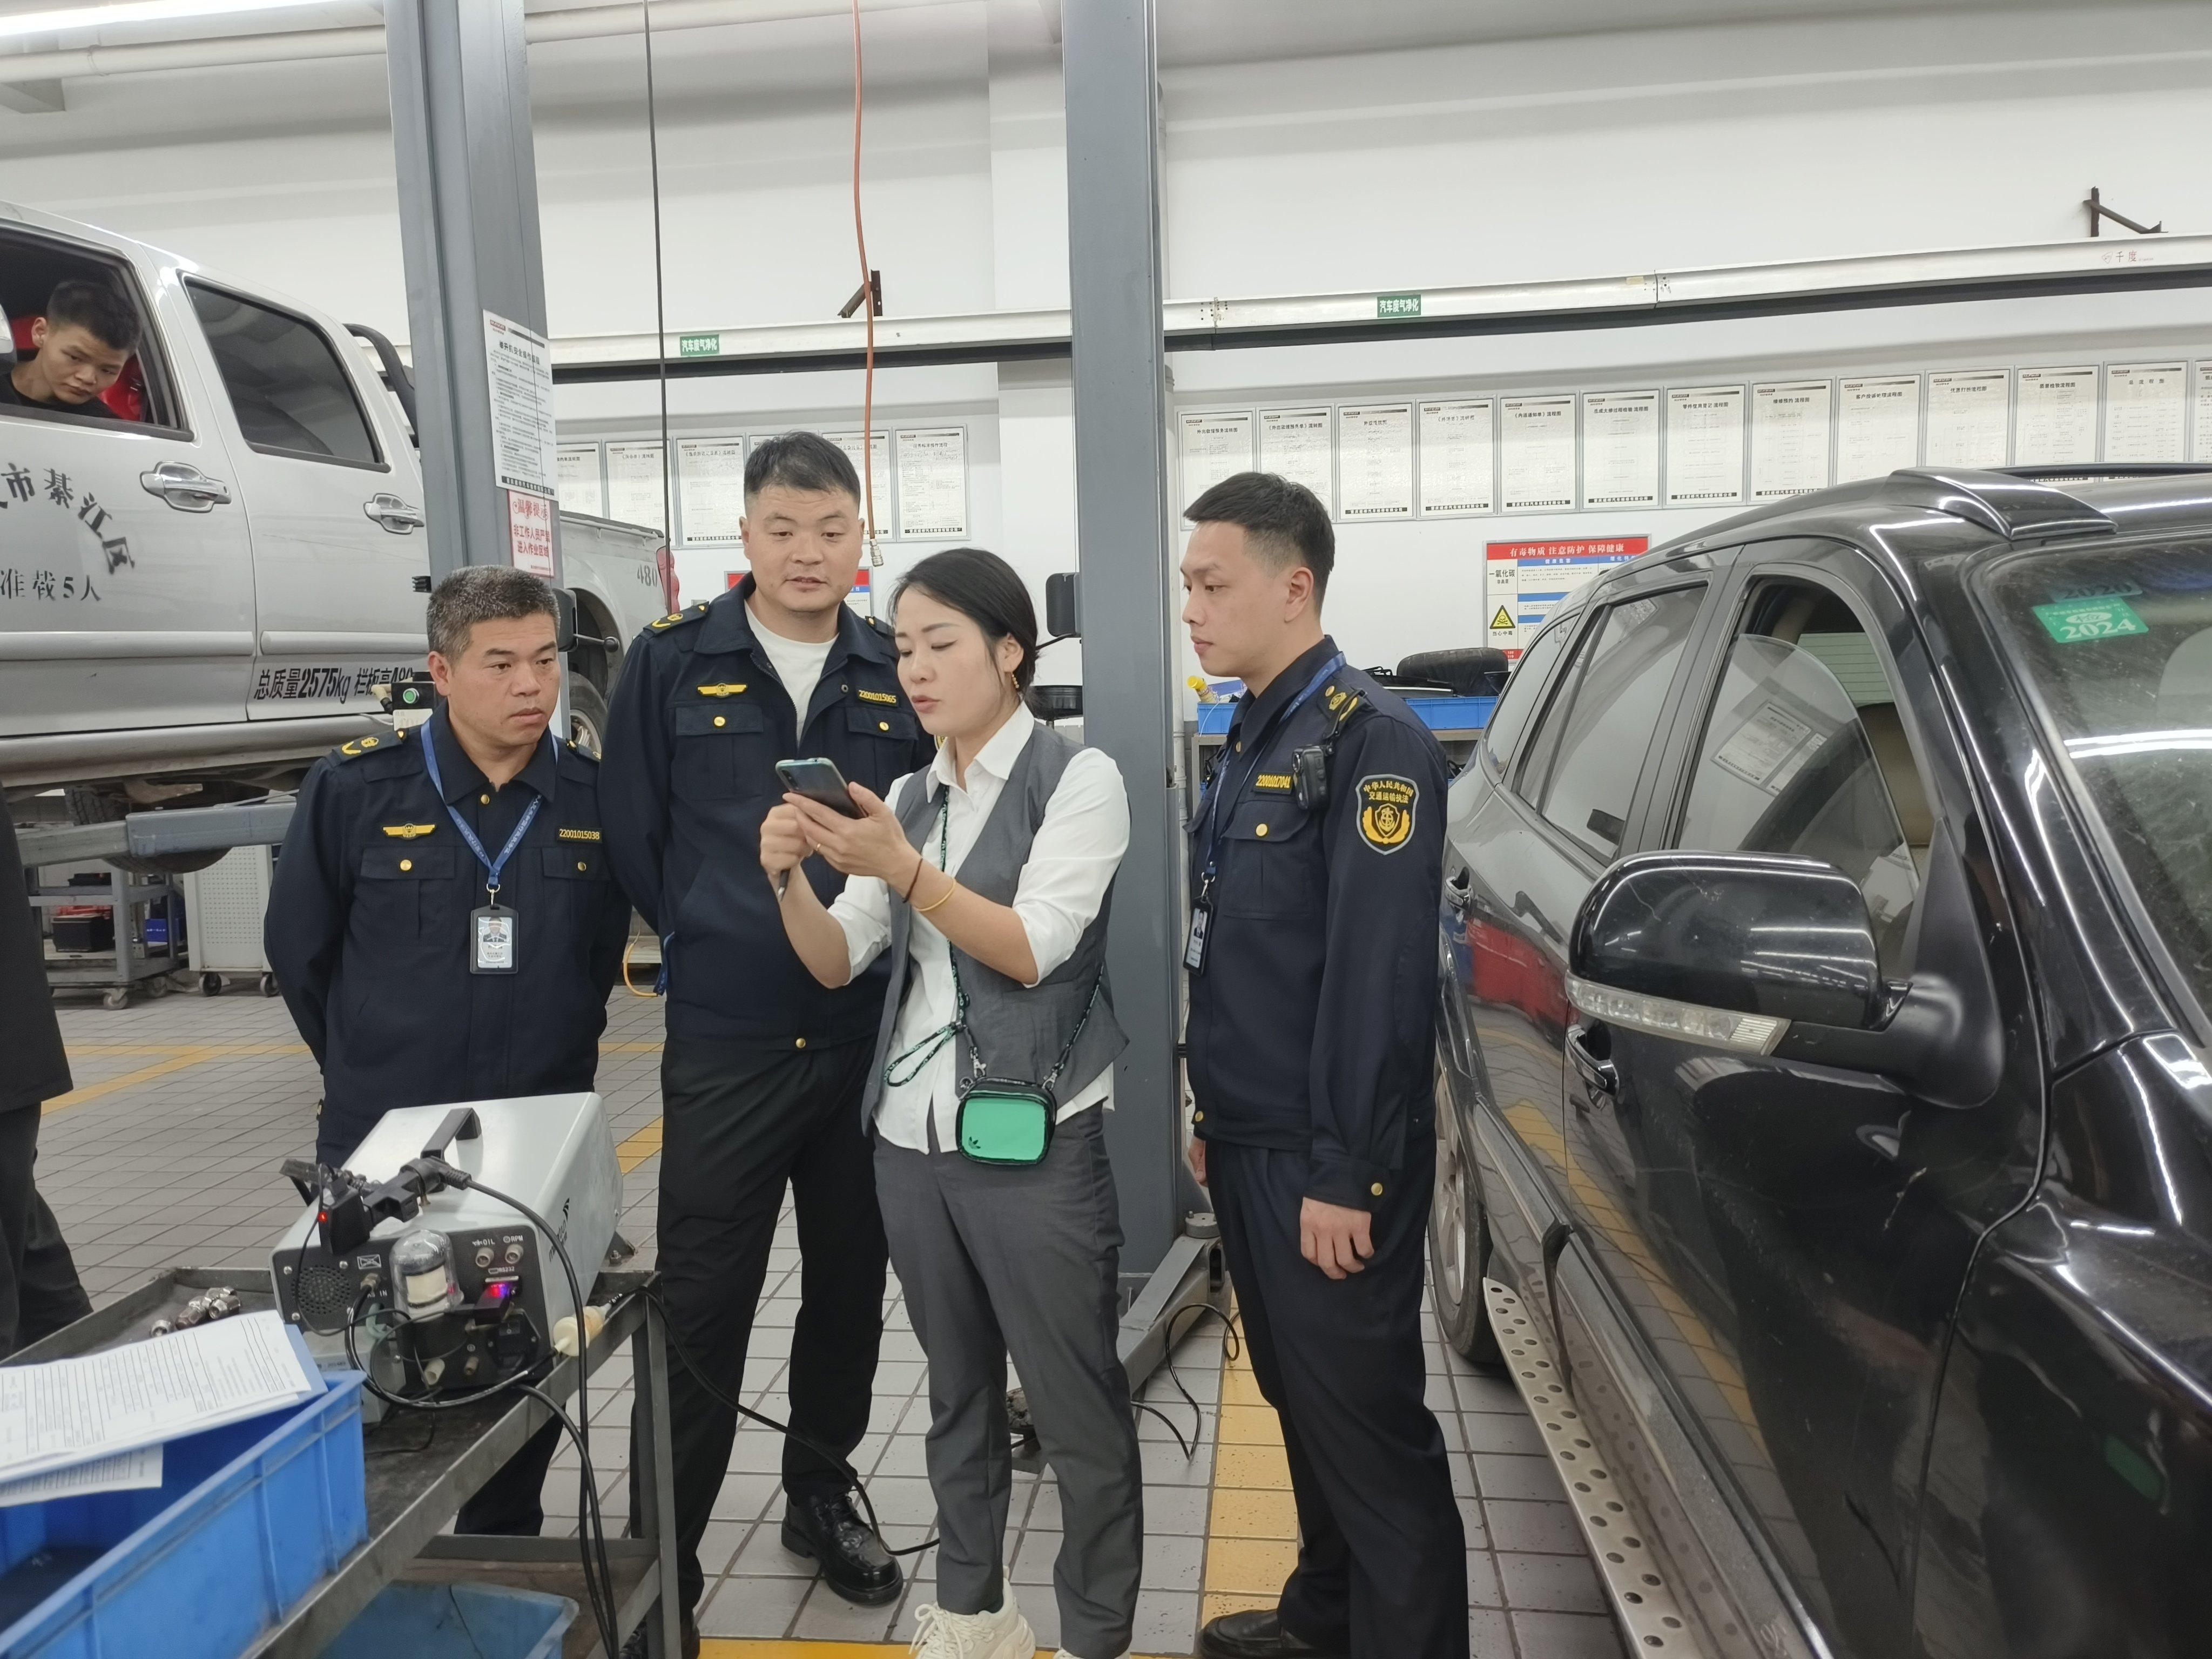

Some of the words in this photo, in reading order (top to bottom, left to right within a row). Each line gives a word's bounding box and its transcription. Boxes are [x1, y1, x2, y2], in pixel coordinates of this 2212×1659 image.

[1380, 298, 1419, 313] 汽车废气净化
[0, 462, 135, 575] 市綦江区
[1509, 546, 1546, 557] 有毒物质
[1548, 544, 1585, 555] 注意防护
[1588, 543, 1625, 554] 保障健康
[637, 564, 658, 588] 480
[1489, 569, 1515, 577] 一氧化碳
[2060, 618, 2136, 639] 2024
[254, 667, 351, 704] 总质量2575kg
[1363, 780, 1414, 798] 中华人民共和国
[1368, 791, 1409, 804] 交通运输执法
[559, 828, 600, 840] 22001015038
